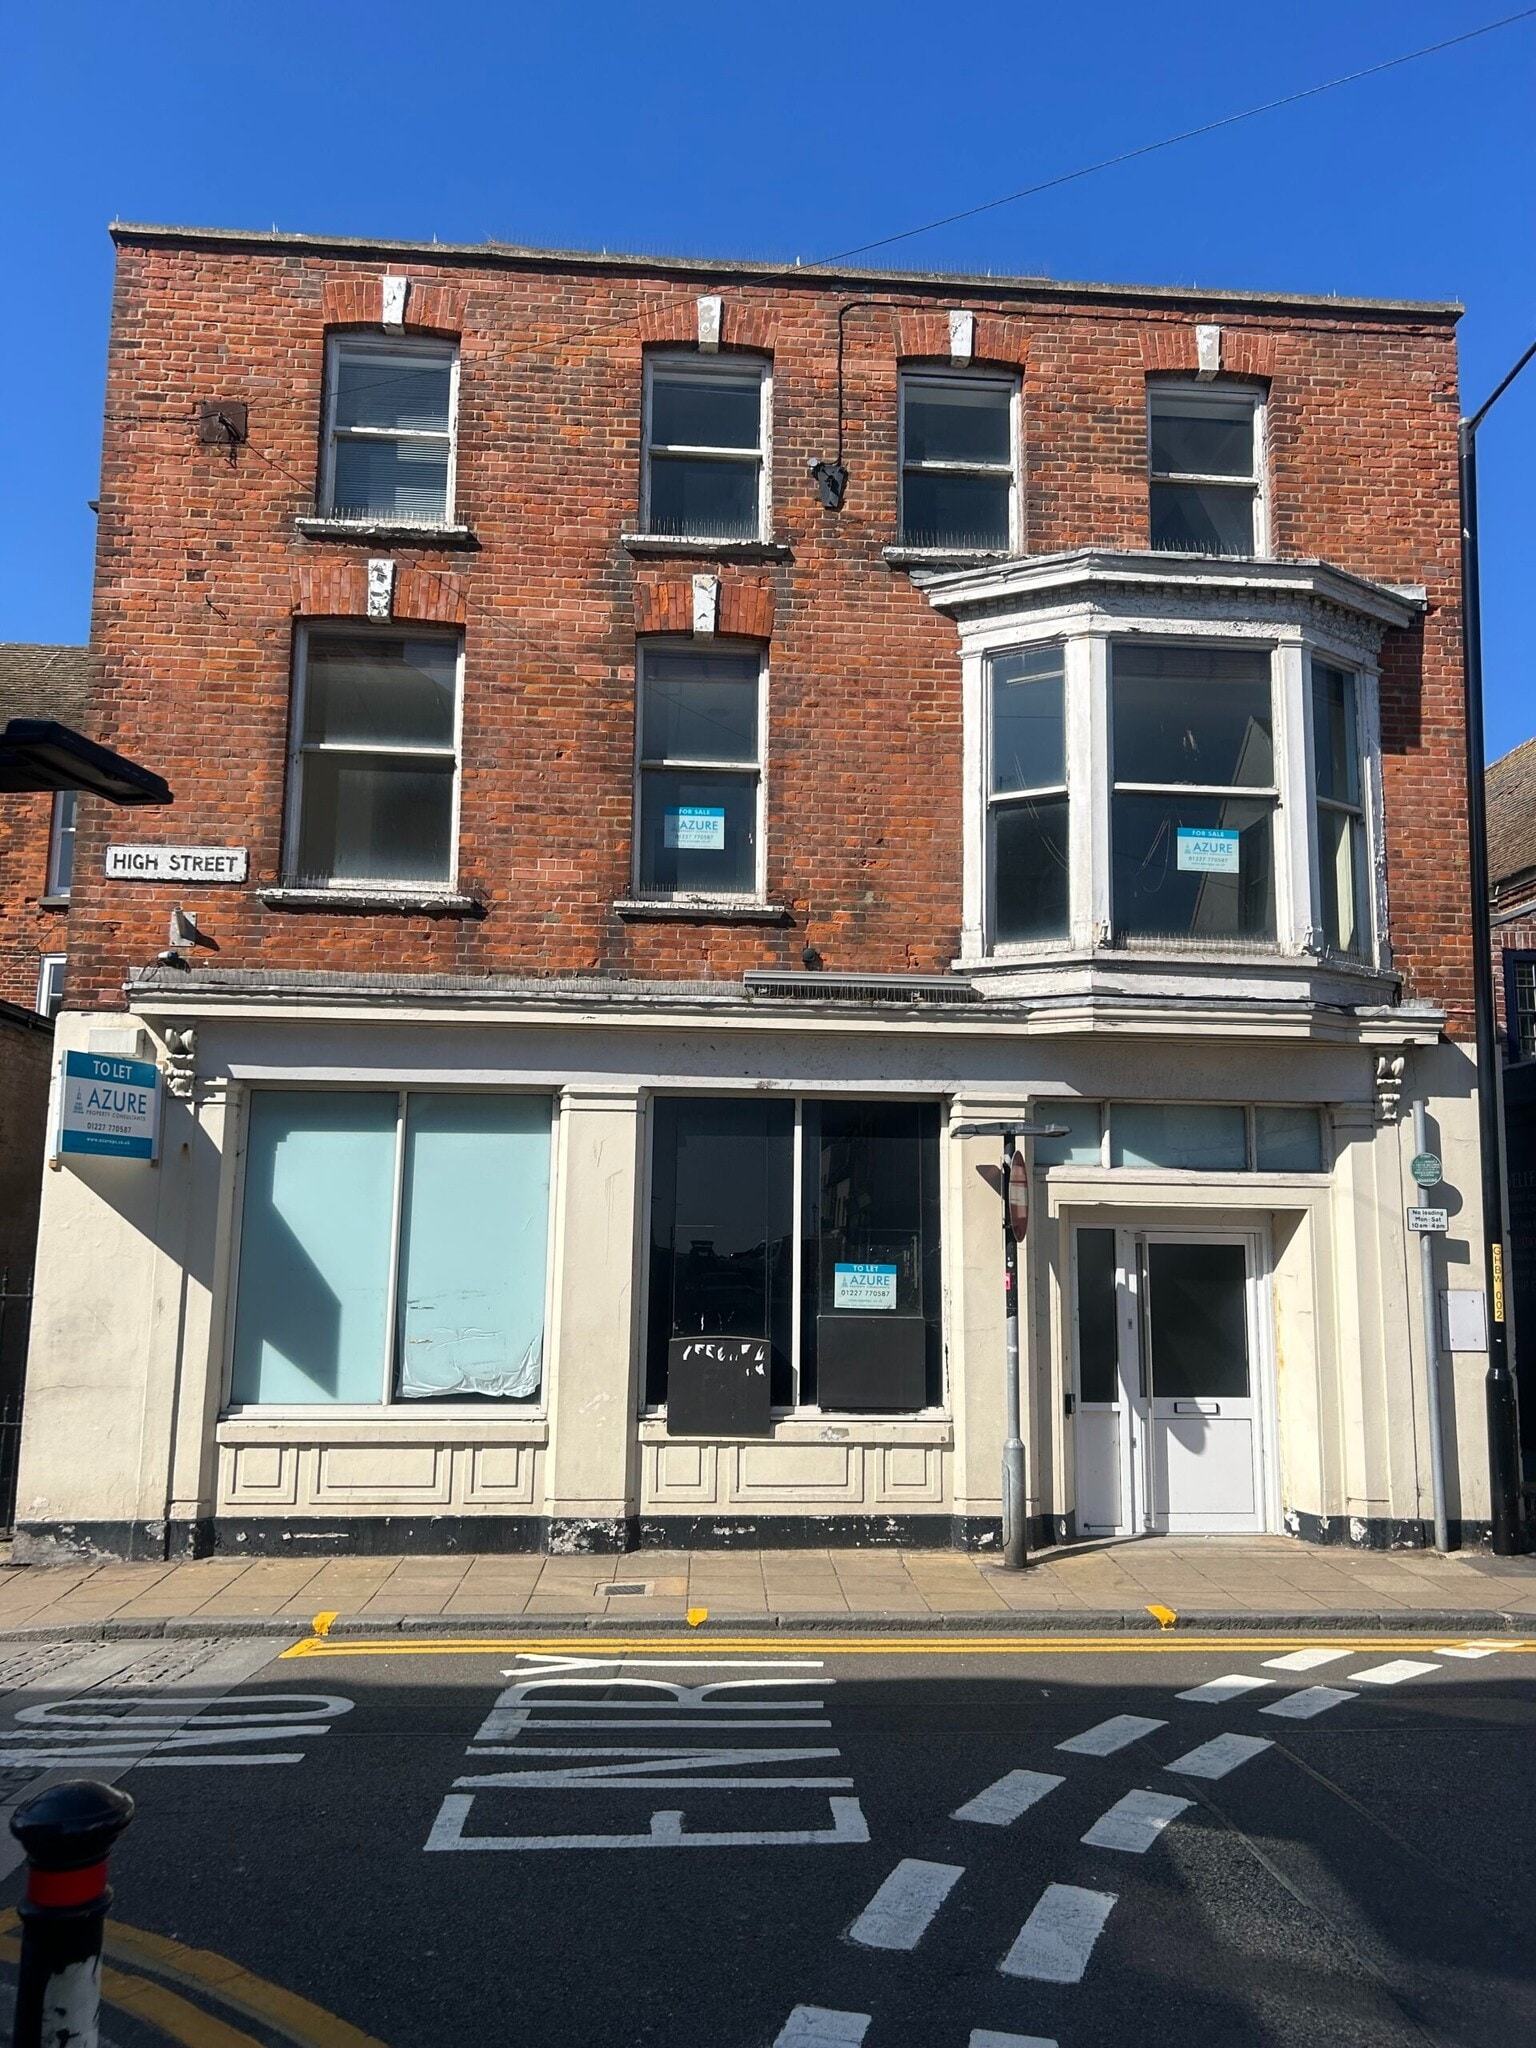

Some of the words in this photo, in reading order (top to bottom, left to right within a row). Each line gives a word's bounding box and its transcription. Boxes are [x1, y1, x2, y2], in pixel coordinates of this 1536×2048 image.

[680, 820, 719, 831] AZURE
[1193, 842, 1233, 854] AZURE
[113, 853, 159, 870] HIGH
[169, 854, 238, 872] STREET
[93, 1060, 110, 1076] TO
[113, 1063, 133, 1080] LET
[87, 1087, 147, 1114] AZURE
[85, 1109, 111, 1118] PROPERTY
[112, 1112, 146, 1122] CONSULTANTS
[87, 1122, 106, 1130] 01227
[108, 1124, 132, 1134] 770587
[850, 1275, 890, 1286] AZURE
[0, 1694, 355, 1767] NO
[423, 1653, 871, 1852] ENTRY
